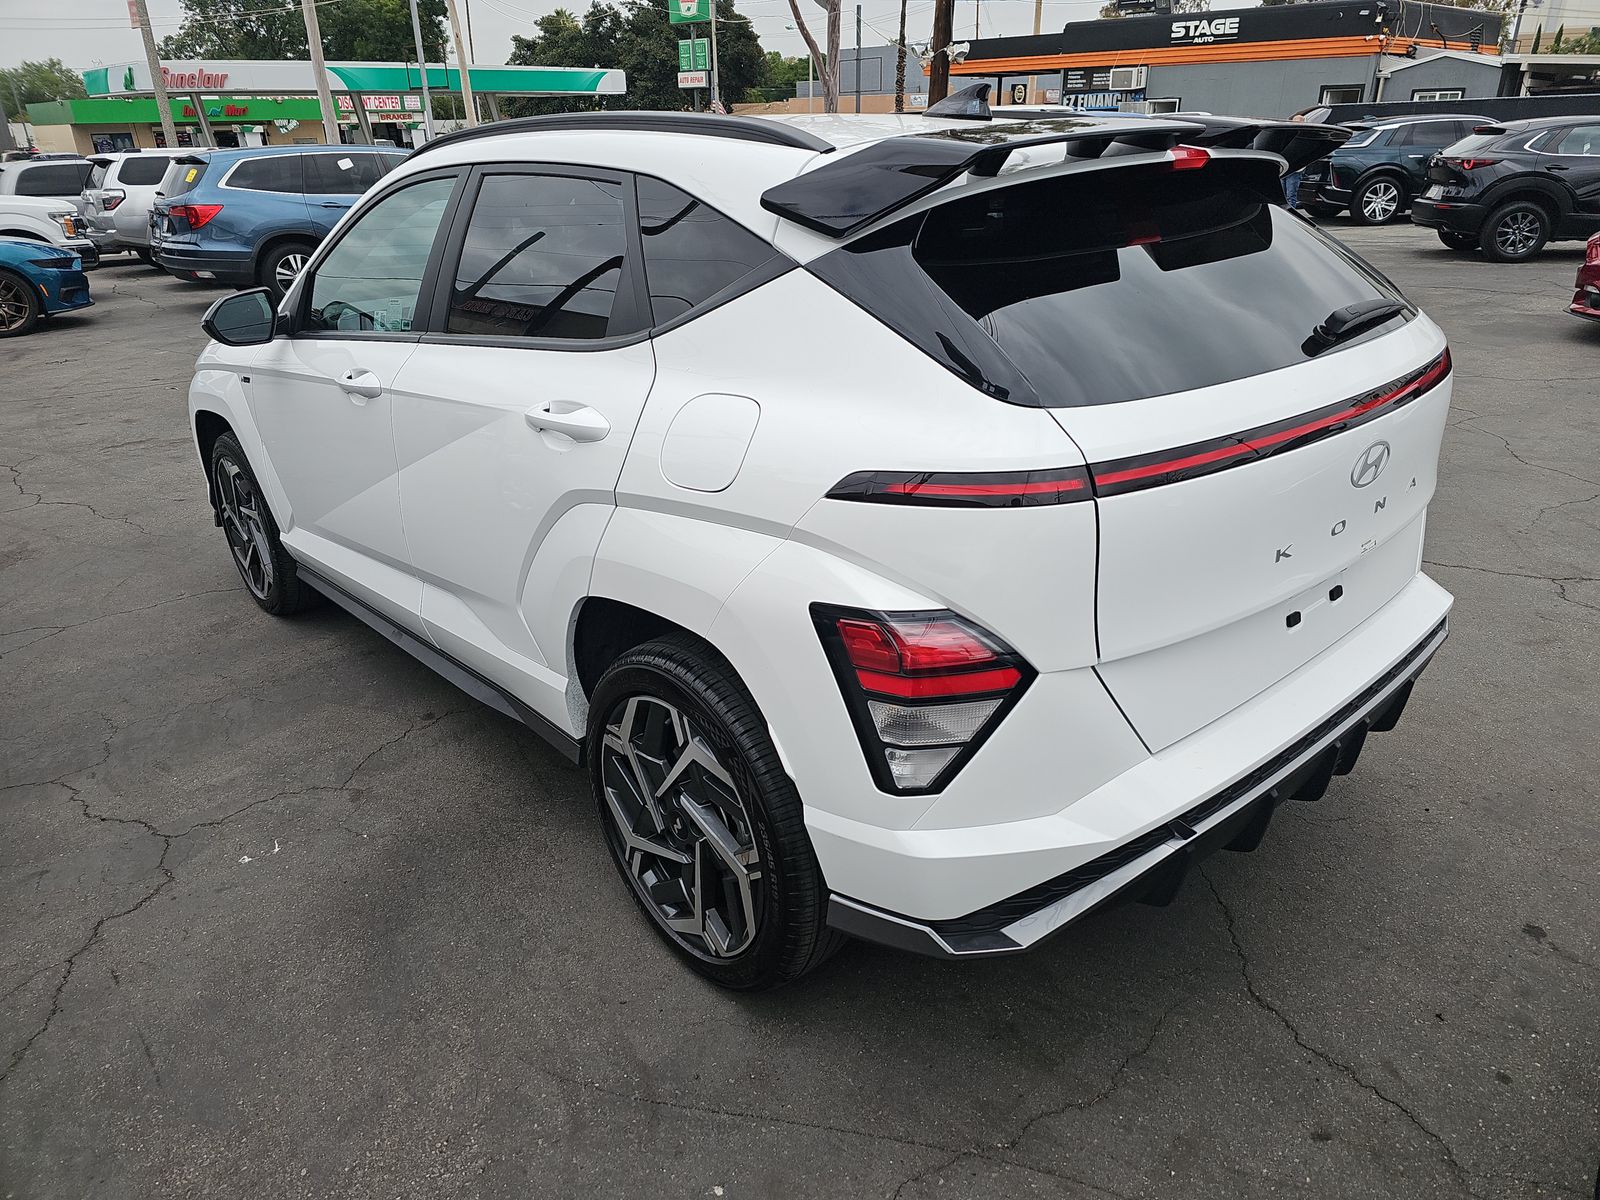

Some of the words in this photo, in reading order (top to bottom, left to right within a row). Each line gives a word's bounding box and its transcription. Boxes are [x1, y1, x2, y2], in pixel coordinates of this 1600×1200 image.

[1171, 17, 1240, 38] STAGE
[159, 66, 229, 89] Sinclair
[690, 76, 704, 84] REPAIR
[372, 95, 400, 110] CENTER
[380, 113, 413, 121] BRAKES
[757, 821, 776, 870] 235/45
